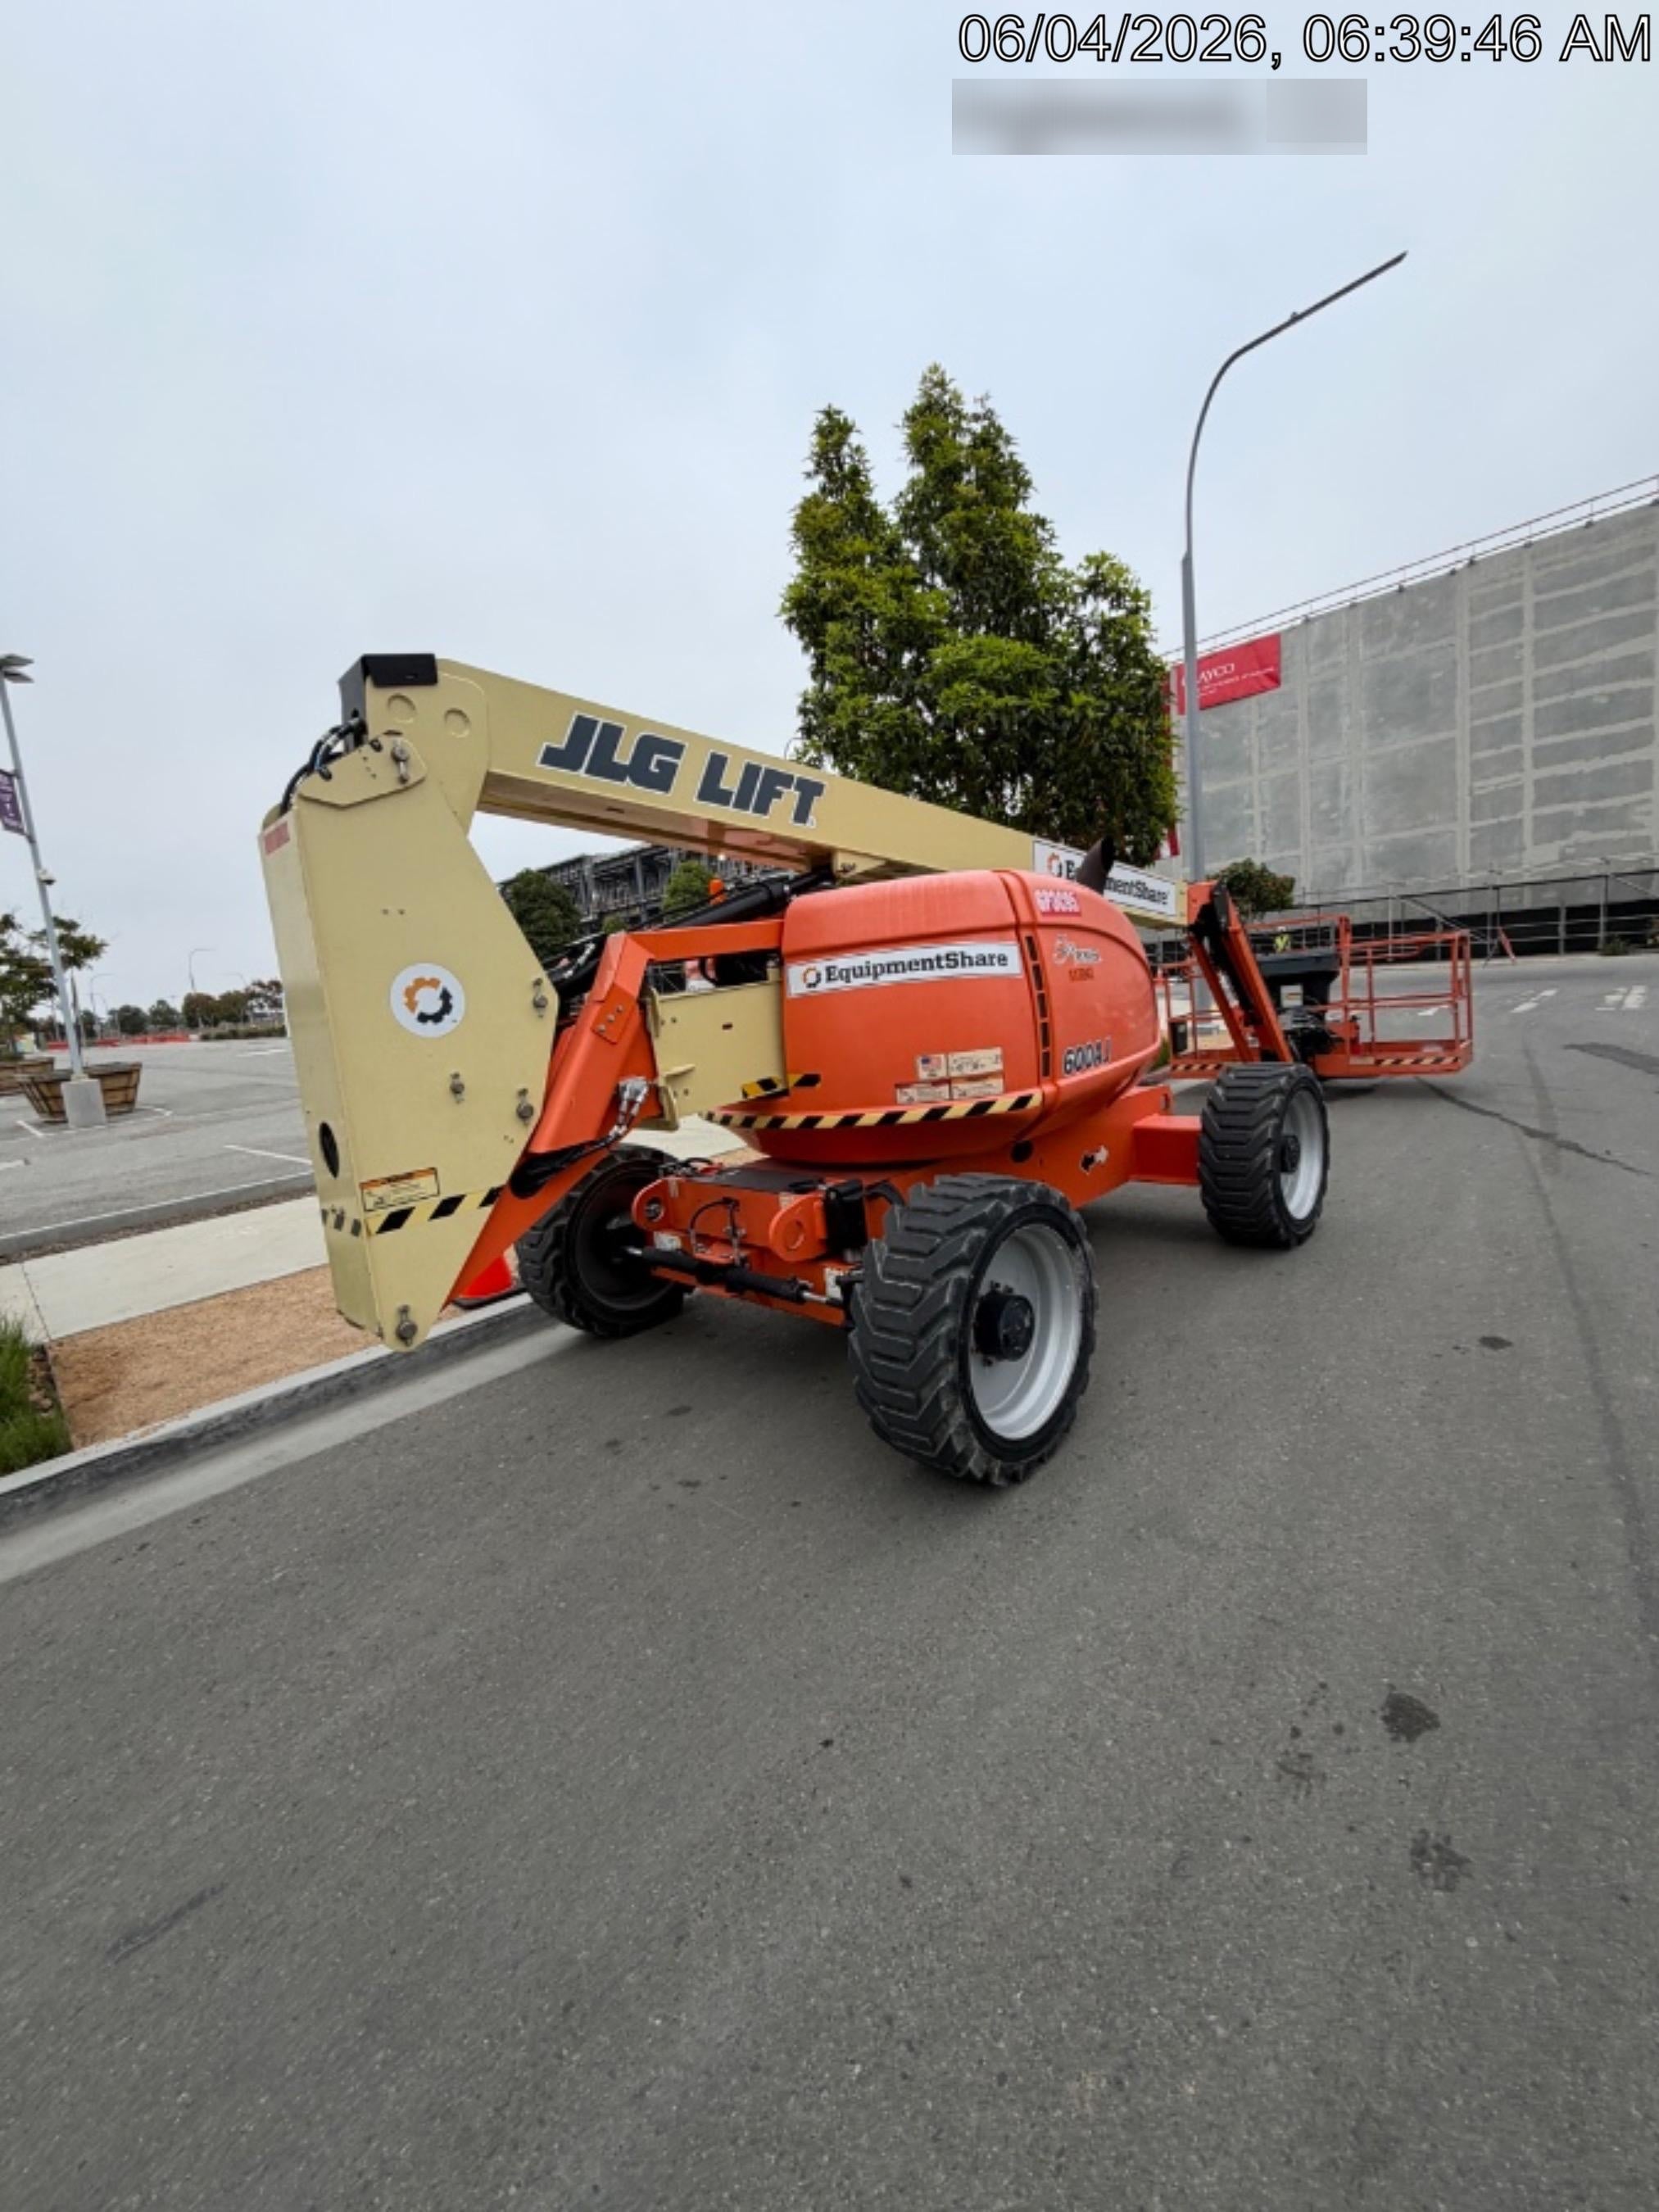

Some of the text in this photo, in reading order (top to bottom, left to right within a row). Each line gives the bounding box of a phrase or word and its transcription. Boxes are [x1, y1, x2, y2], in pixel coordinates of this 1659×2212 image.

[537, 712, 826, 825] JLG LIFT
[824, 951, 1009, 982] EquipmentShare
[1063, 1038, 1112, 1075] 600AJ
